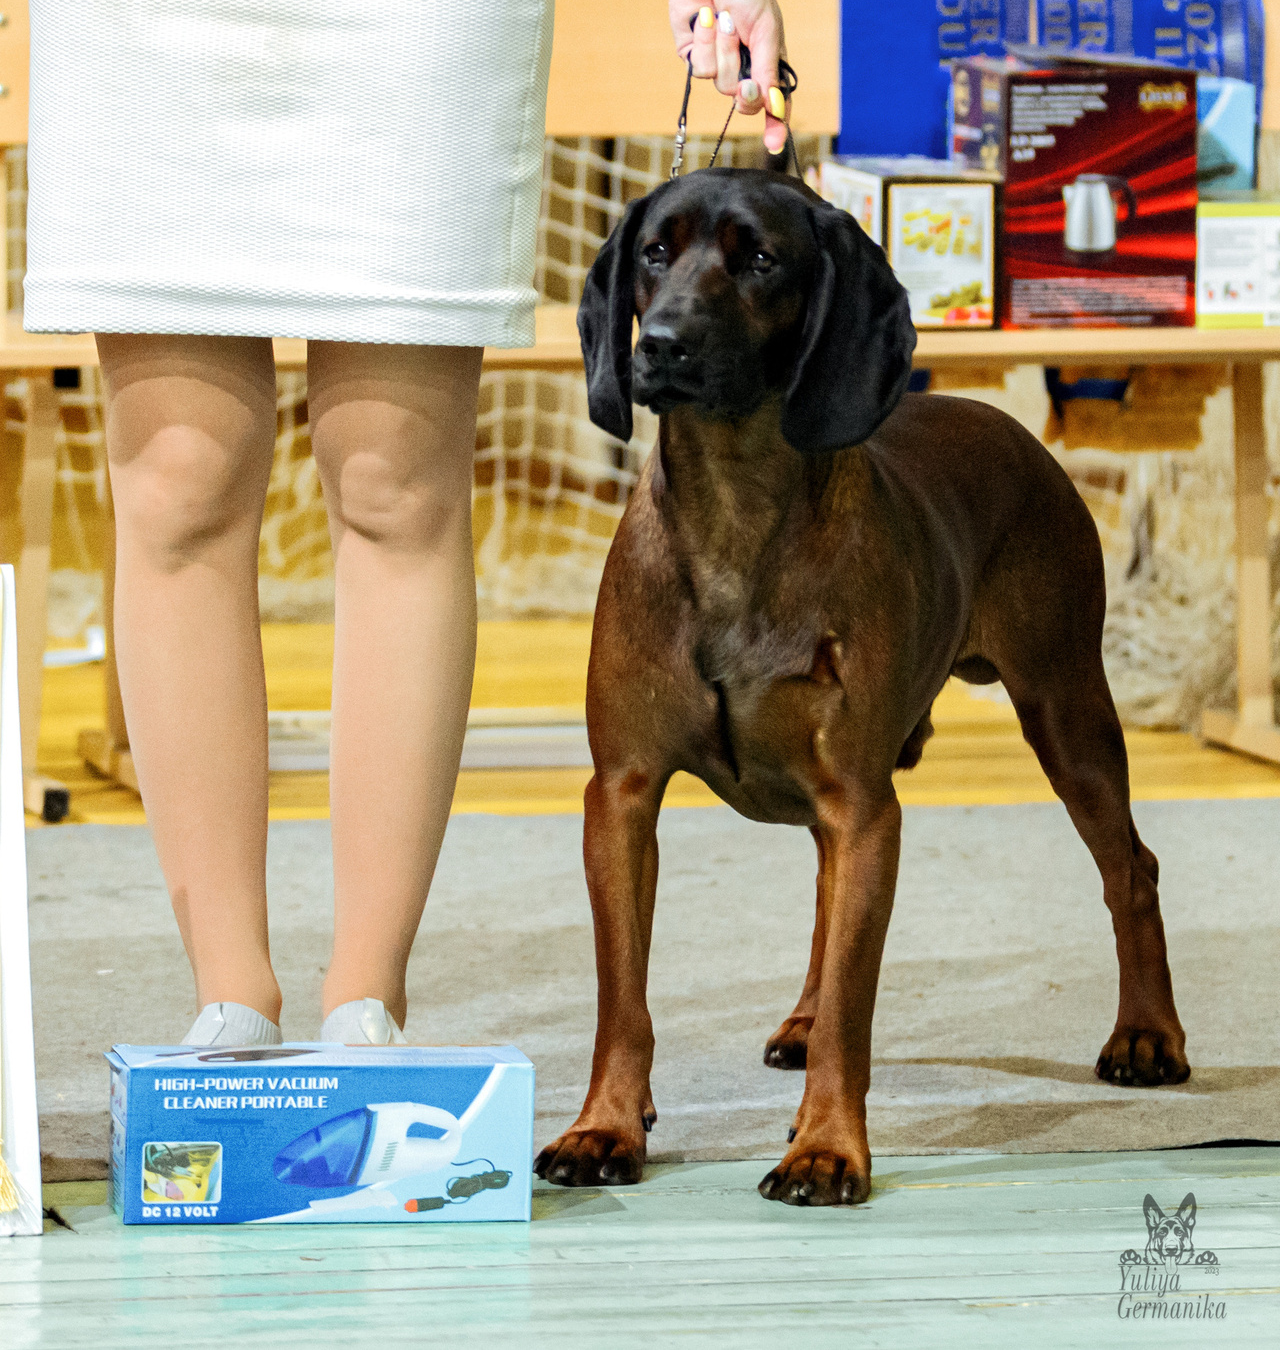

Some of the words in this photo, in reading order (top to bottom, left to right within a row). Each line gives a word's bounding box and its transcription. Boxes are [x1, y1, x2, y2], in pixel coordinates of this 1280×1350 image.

[154, 1077, 264, 1091] HIGH-POWER
[267, 1077, 339, 1090] VACUUM
[163, 1096, 238, 1110] CLEANER
[241, 1095, 329, 1109] PORTABLE
[142, 1206, 163, 1218] DC
[165, 1206, 181, 1218] 12
[183, 1206, 219, 1218] VOLT
